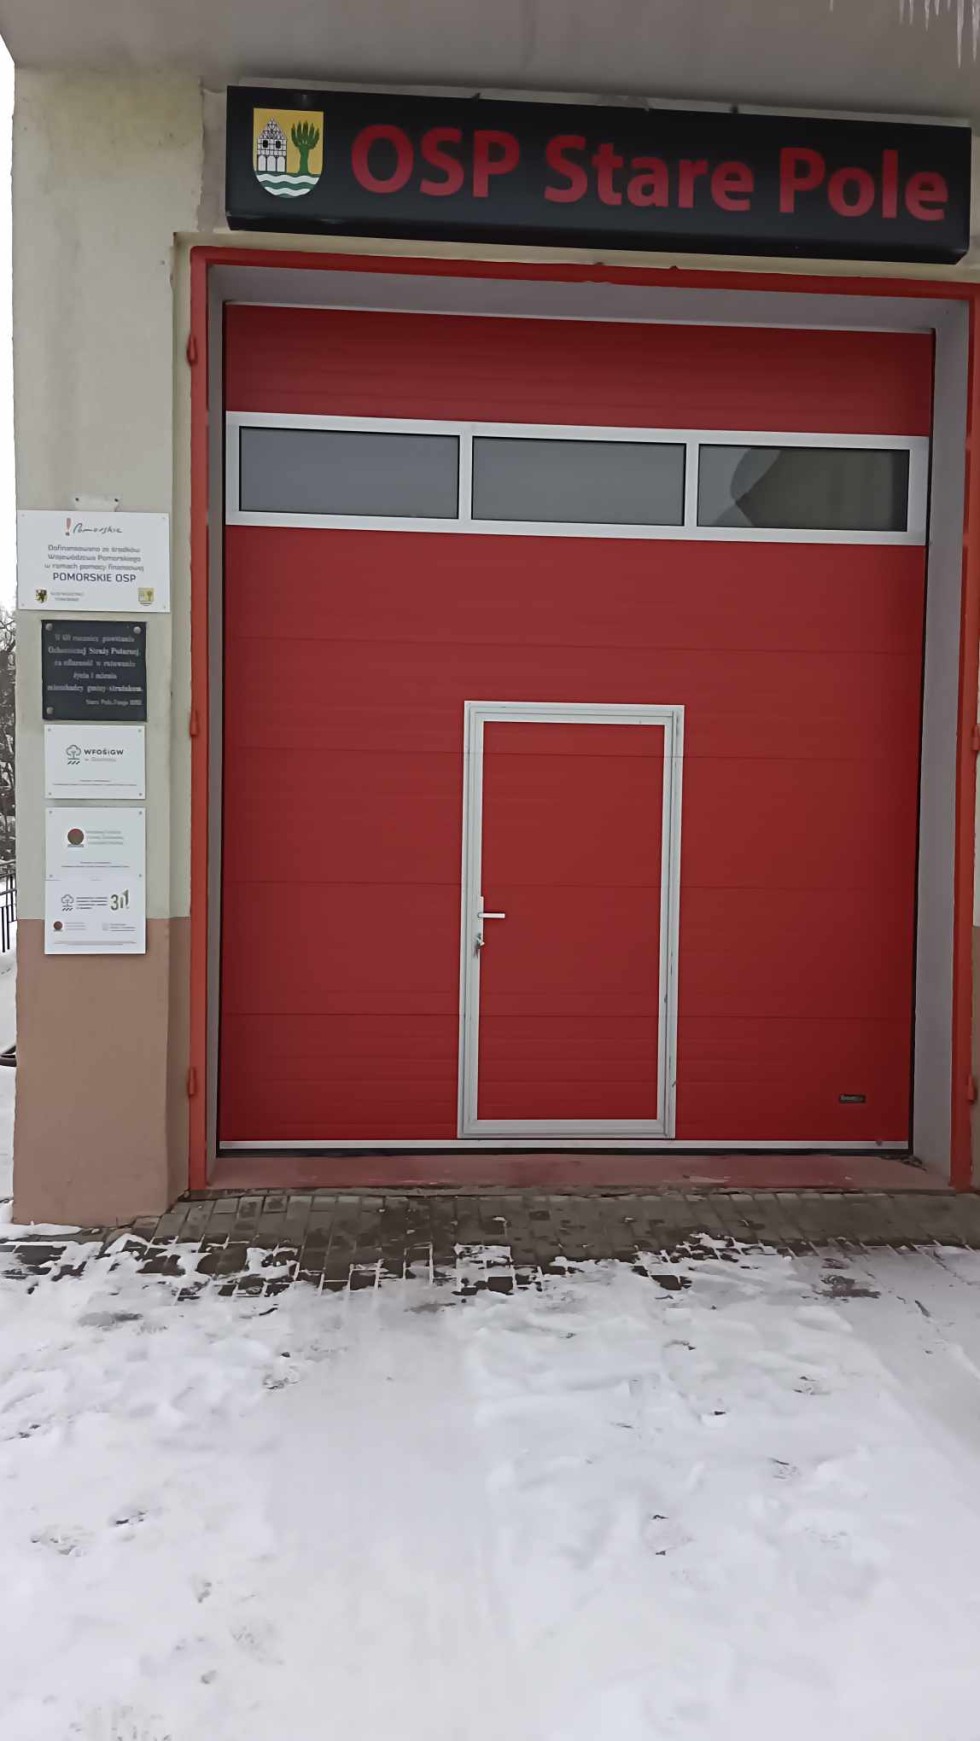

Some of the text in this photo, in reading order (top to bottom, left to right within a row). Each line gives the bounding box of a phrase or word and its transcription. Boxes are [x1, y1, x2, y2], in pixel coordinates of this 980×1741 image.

[351, 123, 948, 222] OSP Stare Pole
[97, 554, 141, 563] Pomorskiego
[79, 564, 106, 572] pomocy
[108, 563, 144, 572] finansowej
[53, 572, 136, 583] POMORSKIE OSP
